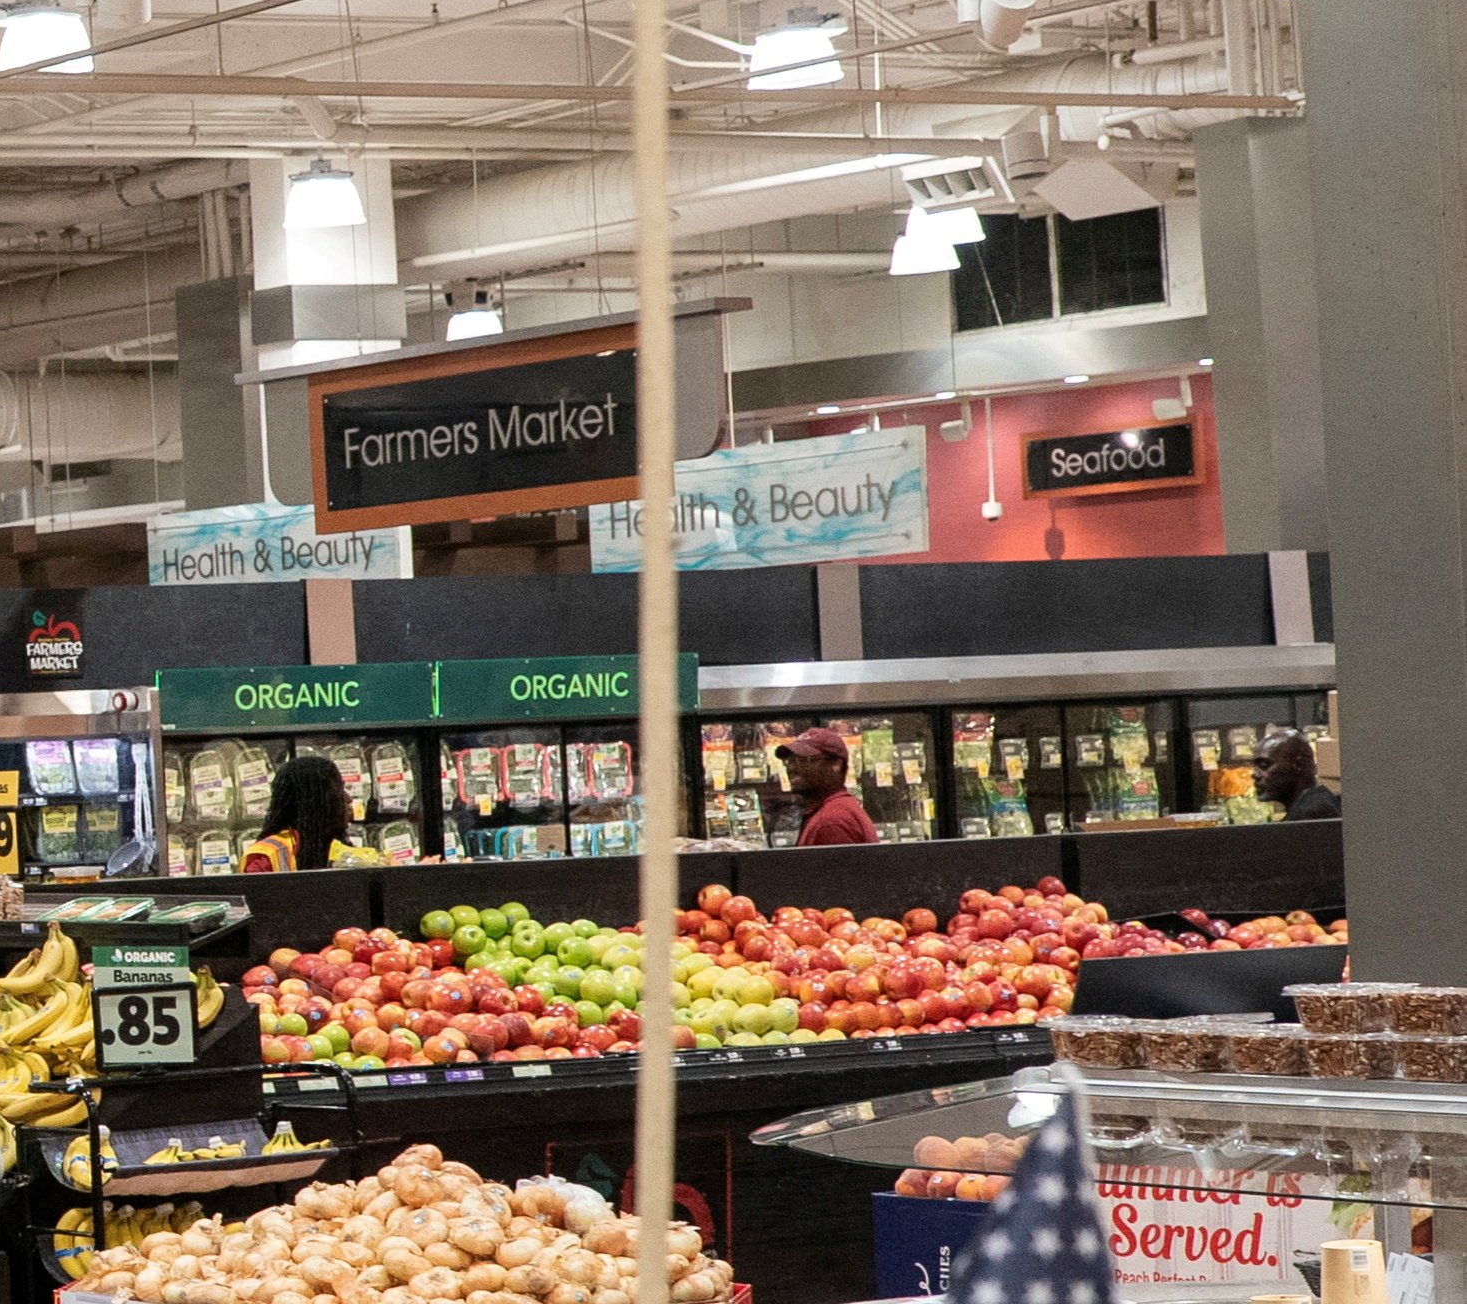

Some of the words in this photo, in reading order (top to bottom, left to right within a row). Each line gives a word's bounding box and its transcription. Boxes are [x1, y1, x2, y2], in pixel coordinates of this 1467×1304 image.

[343, 419, 479, 469] Farmers
[488, 393, 619, 451] Market
[1051, 437, 1165, 478] Seafood
[732, 488, 758, 527] &
[770, 472, 897, 524] Beauty
[163, 543, 245, 582] Health
[254, 539, 273, 572] &
[281, 532, 375, 571] Beauty
[26, 642, 83, 656] FARMERS
[30, 656, 78, 670] MARKET
[235, 681, 360, 711] ORGANIC
[510, 672, 630, 701] ORGANIC
[124, 952, 175, 963] ORGANIC
[113, 970, 173, 983] Bananas
[101, 996, 180, 1046] .85
[1266, 1173, 1303, 1208] is
[1109, 1203, 1277, 1266] Served.
[1115, 1269, 1149, 1284] Peach
